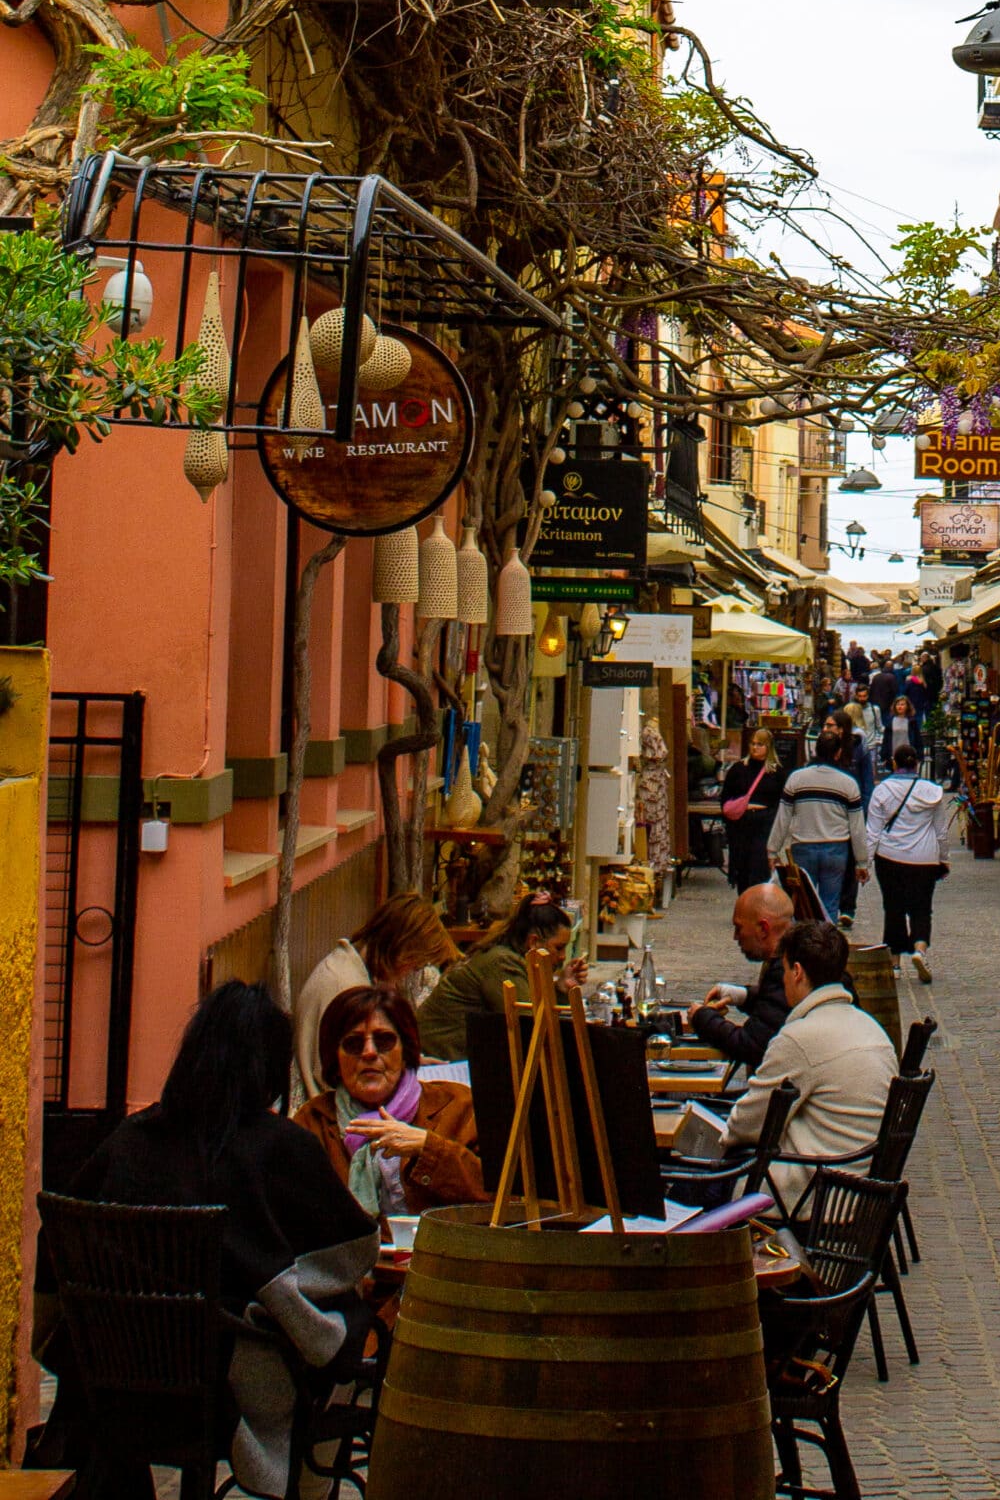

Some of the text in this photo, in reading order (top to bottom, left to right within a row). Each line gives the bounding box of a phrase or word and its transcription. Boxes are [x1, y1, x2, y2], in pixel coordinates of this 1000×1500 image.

[283, 441, 449, 460] WNE RESTAURANT
[538, 528, 603, 541] Kritamon
[941, 534, 982, 548] Rooms
[601, 666, 647, 680] Shalom
